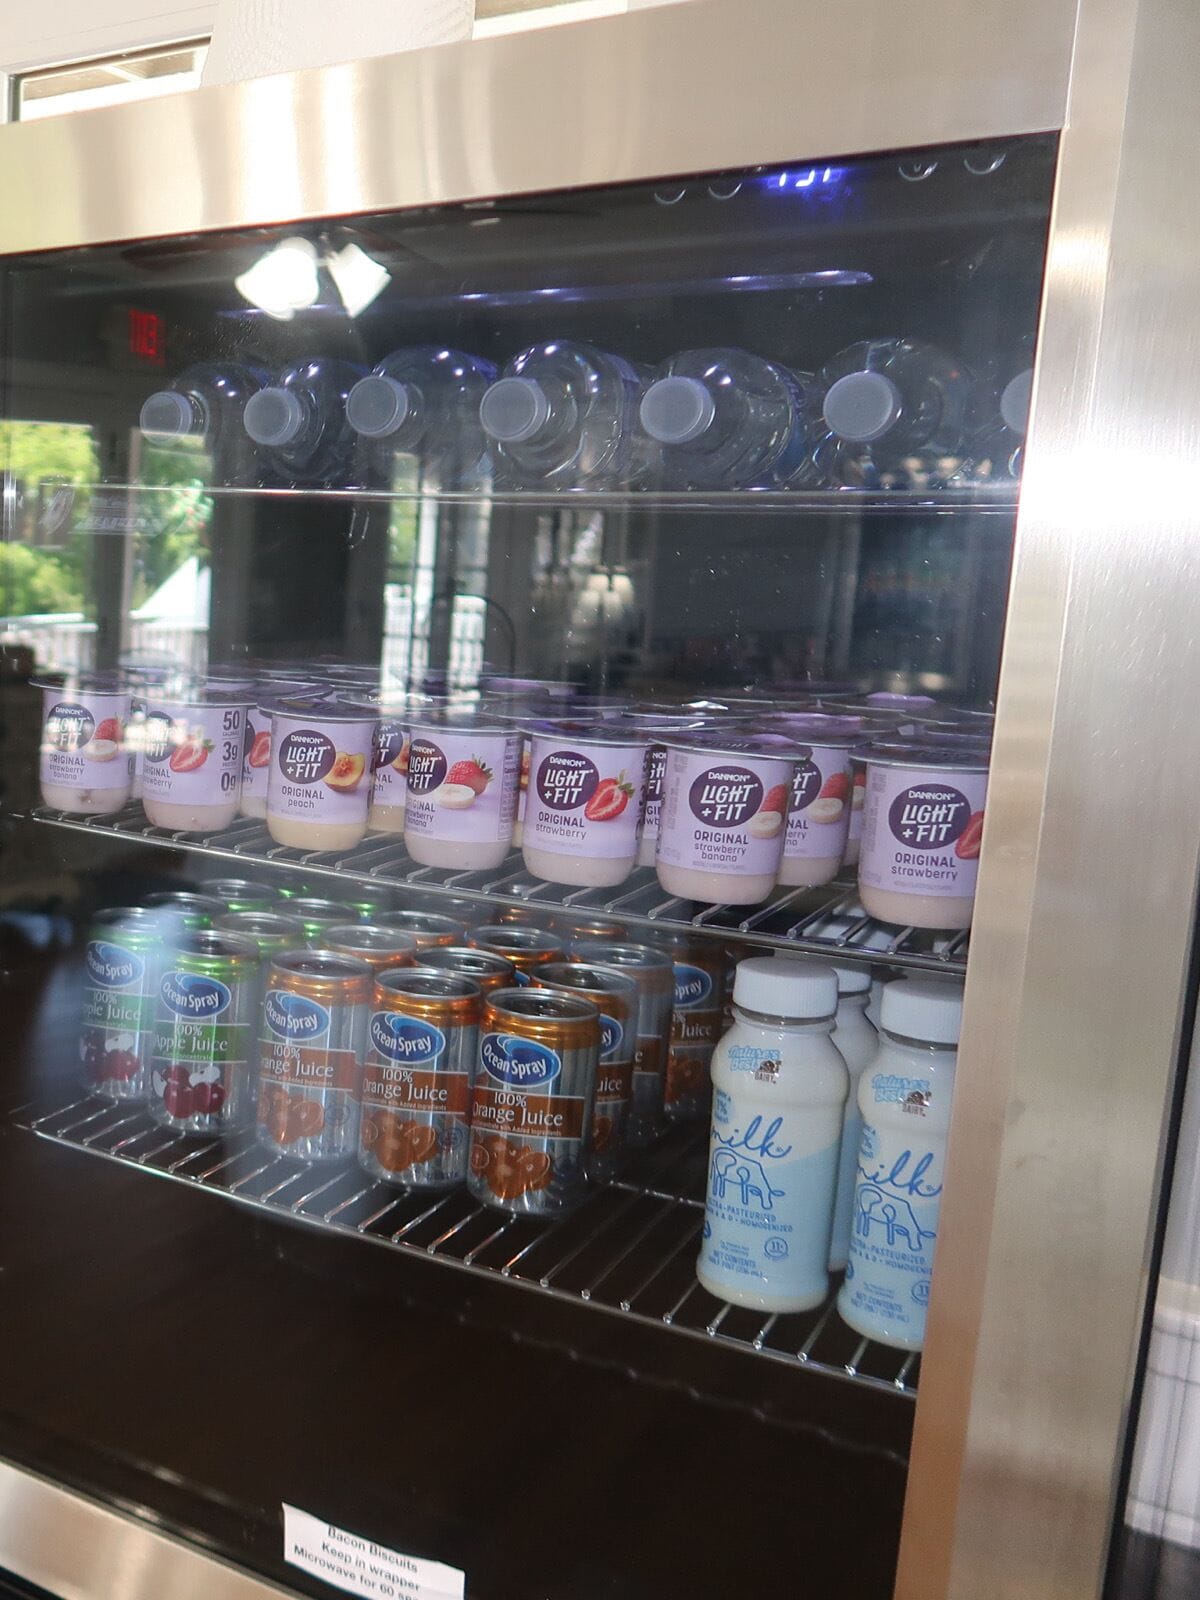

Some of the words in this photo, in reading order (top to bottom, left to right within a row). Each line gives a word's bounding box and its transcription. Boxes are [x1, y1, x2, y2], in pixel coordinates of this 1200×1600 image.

[223, 710, 240, 731] 50
[290, 734, 321, 744] DANNON
[222, 741, 238, 761] 3g
[286, 745, 327, 763] LIGHT
[49, 754, 85, 767] ORIGINAL
[549, 756, 583, 768] DANNON
[220, 772, 237, 792] 0g
[543, 768, 590, 788] LIGHT
[708, 771, 747, 782] DANNON
[281, 785, 325, 800] ORIGINAL
[700, 784, 755, 805] LIGHT
[908, 790, 951, 801] DANNON
[287, 799, 315, 809] peach
[538, 811, 585, 828] ORIGINAL
[900, 803, 960, 825] LIGHT
[535, 823, 587, 840] strawberry
[694, 830, 749, 845] ORIGINAL
[693, 843, 747, 856] strawberry
[701, 851, 738, 863] banana
[894, 852, 956, 868] ORIGINAL
[891, 865, 958, 881] strawberry
[105, 962, 133, 980] Spray
[162, 982, 187, 1008] Ocean
[188, 991, 219, 1013] Spray
[265, 1000, 286, 1028] Ocean
[287, 1013, 318, 1034] Spray
[372, 1022, 397, 1050] Ocean
[398, 1035, 432, 1056] Spray
[273, 1043, 301, 1059] 100%
[295, 1060, 334, 1078] Juice
[483, 1043, 510, 1073] Ocean
[511, 1058, 547, 1080] Spray
[382, 1067, 414, 1083] 100%
[362, 1078, 402, 1099] Orange
[407, 1083, 448, 1101] Juice
[494, 1091, 528, 1107] 100%
[472, 1101, 515, 1124] Orange
[520, 1107, 564, 1127] Juice
[327, 1525, 367, 1552] Bacon
[369, 1543, 419, 1574] Biscuits
[293, 1544, 357, 1580] Microwave
[359, 1573, 377, 1589] for
[379, 1584, 395, 1596] 60
[321, 1541, 353, 1566] Keep
[355, 1557, 367, 1570] in
[369, 1564, 421, 1592] wrapper
